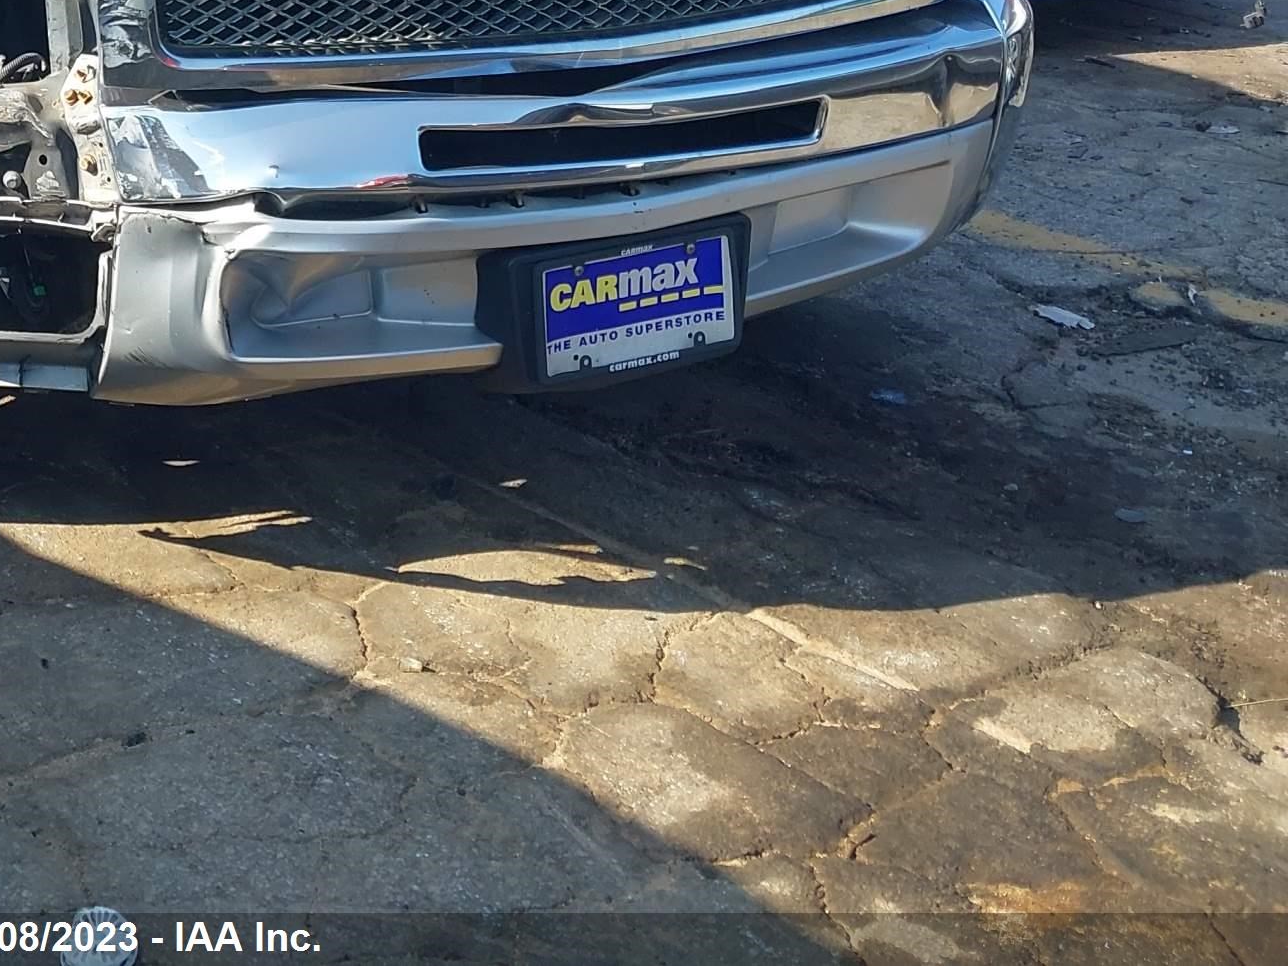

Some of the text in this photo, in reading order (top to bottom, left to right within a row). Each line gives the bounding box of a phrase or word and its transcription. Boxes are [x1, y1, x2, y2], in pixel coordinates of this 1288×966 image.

[547, 310, 726, 355] THE AUTO SUPERSTORE
[609, 349, 680, 374] carmax.com
